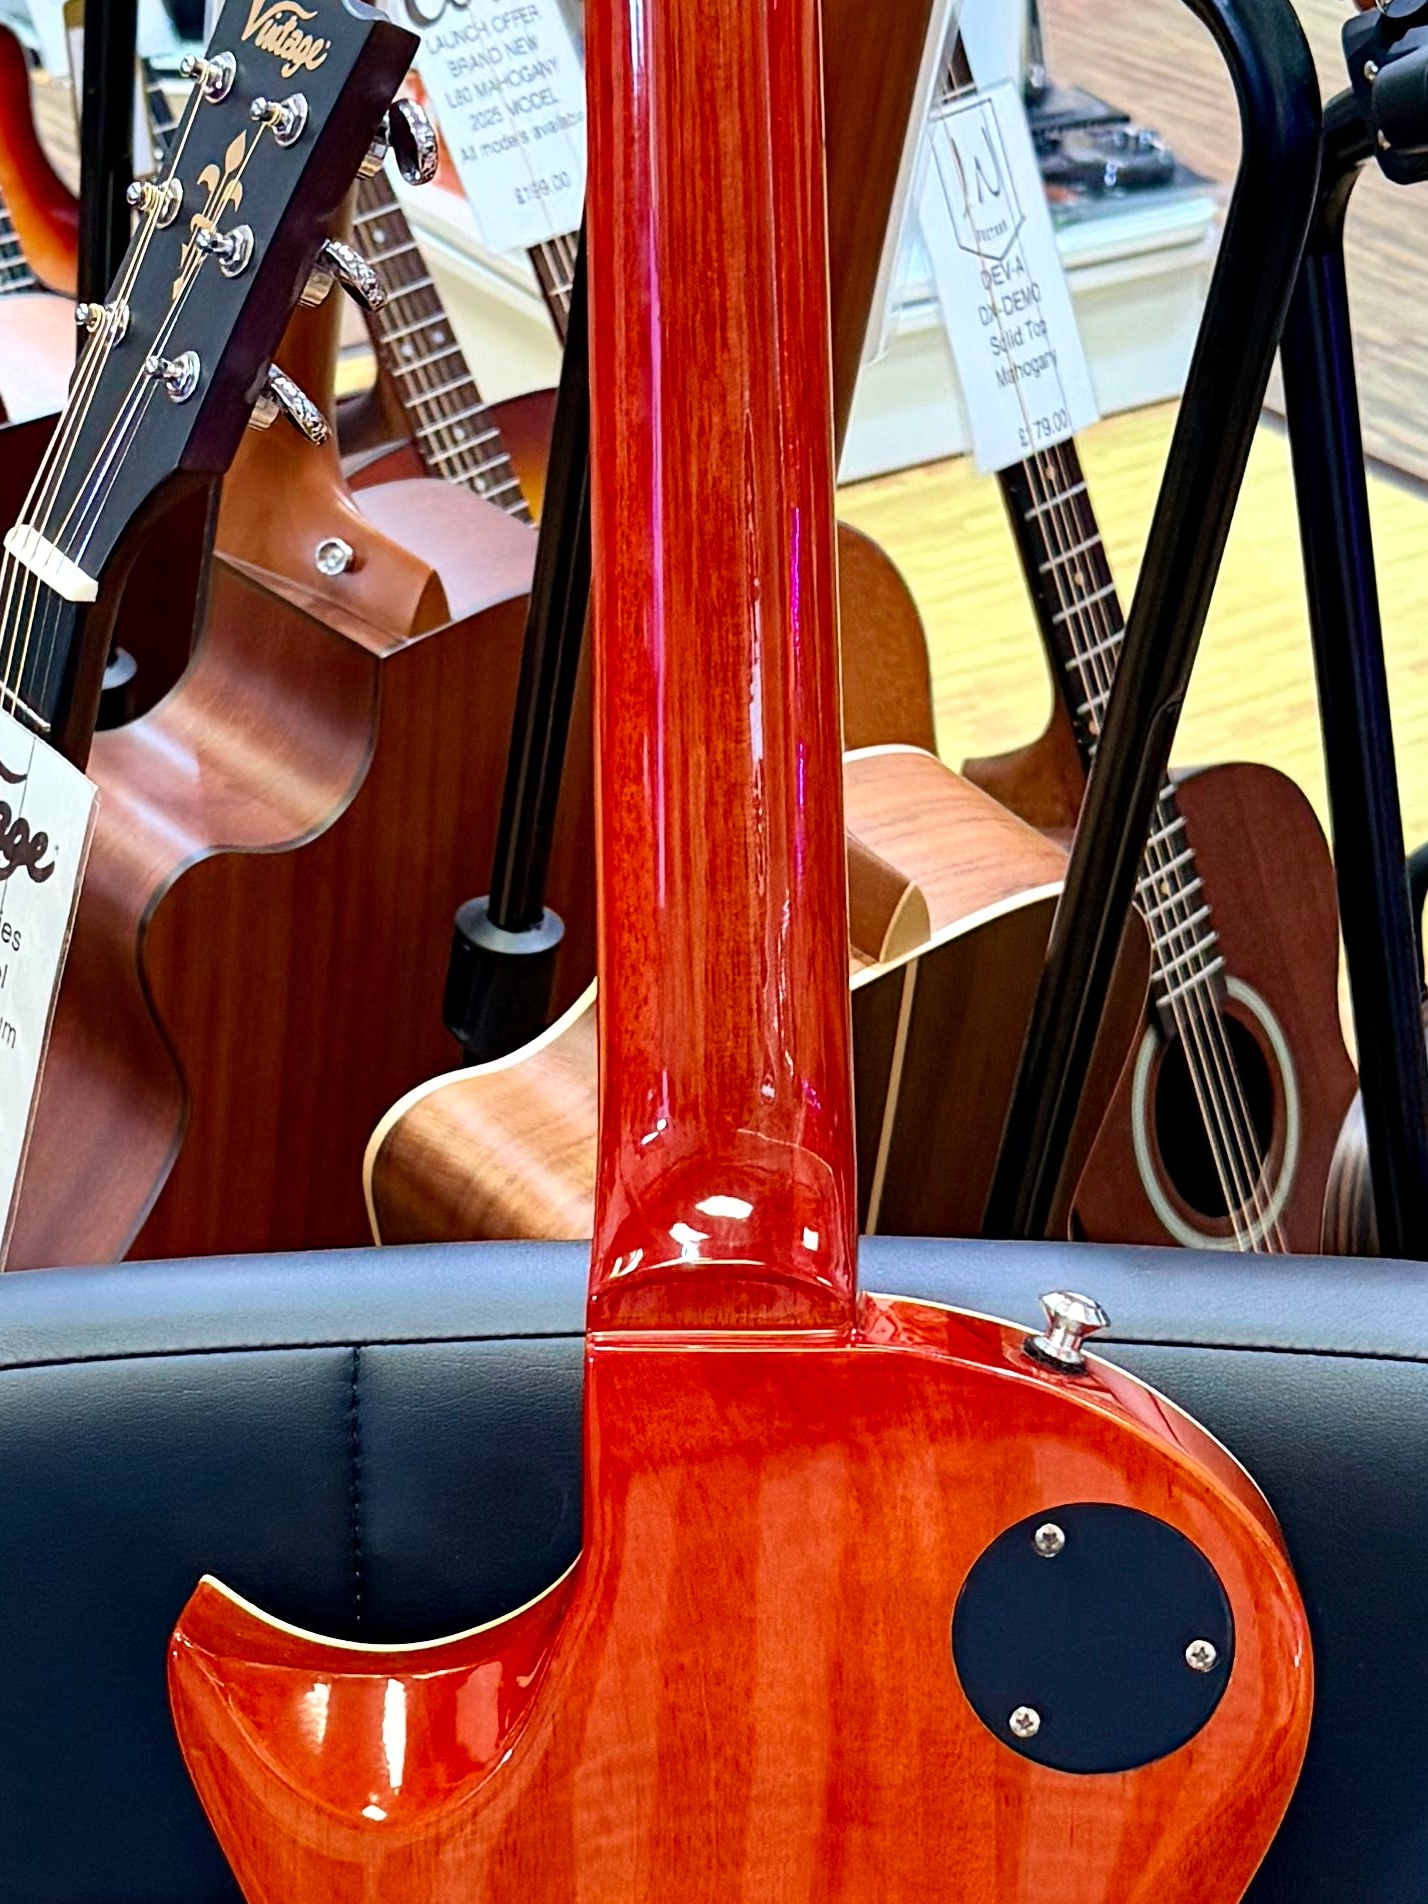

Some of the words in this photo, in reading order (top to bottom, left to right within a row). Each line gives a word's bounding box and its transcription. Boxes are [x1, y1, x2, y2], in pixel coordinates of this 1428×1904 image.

[425, 19, 491, 56] LAUNCH
[492, 3, 541, 34] OFFER
[446, 47, 503, 79] BRAND
[505, 34, 540, 59] NEW
[474, 56, 560, 98] MAHOGANY
[506, 87, 561, 117] MODEL
[1018, 407, 1069, 449] £79.00
